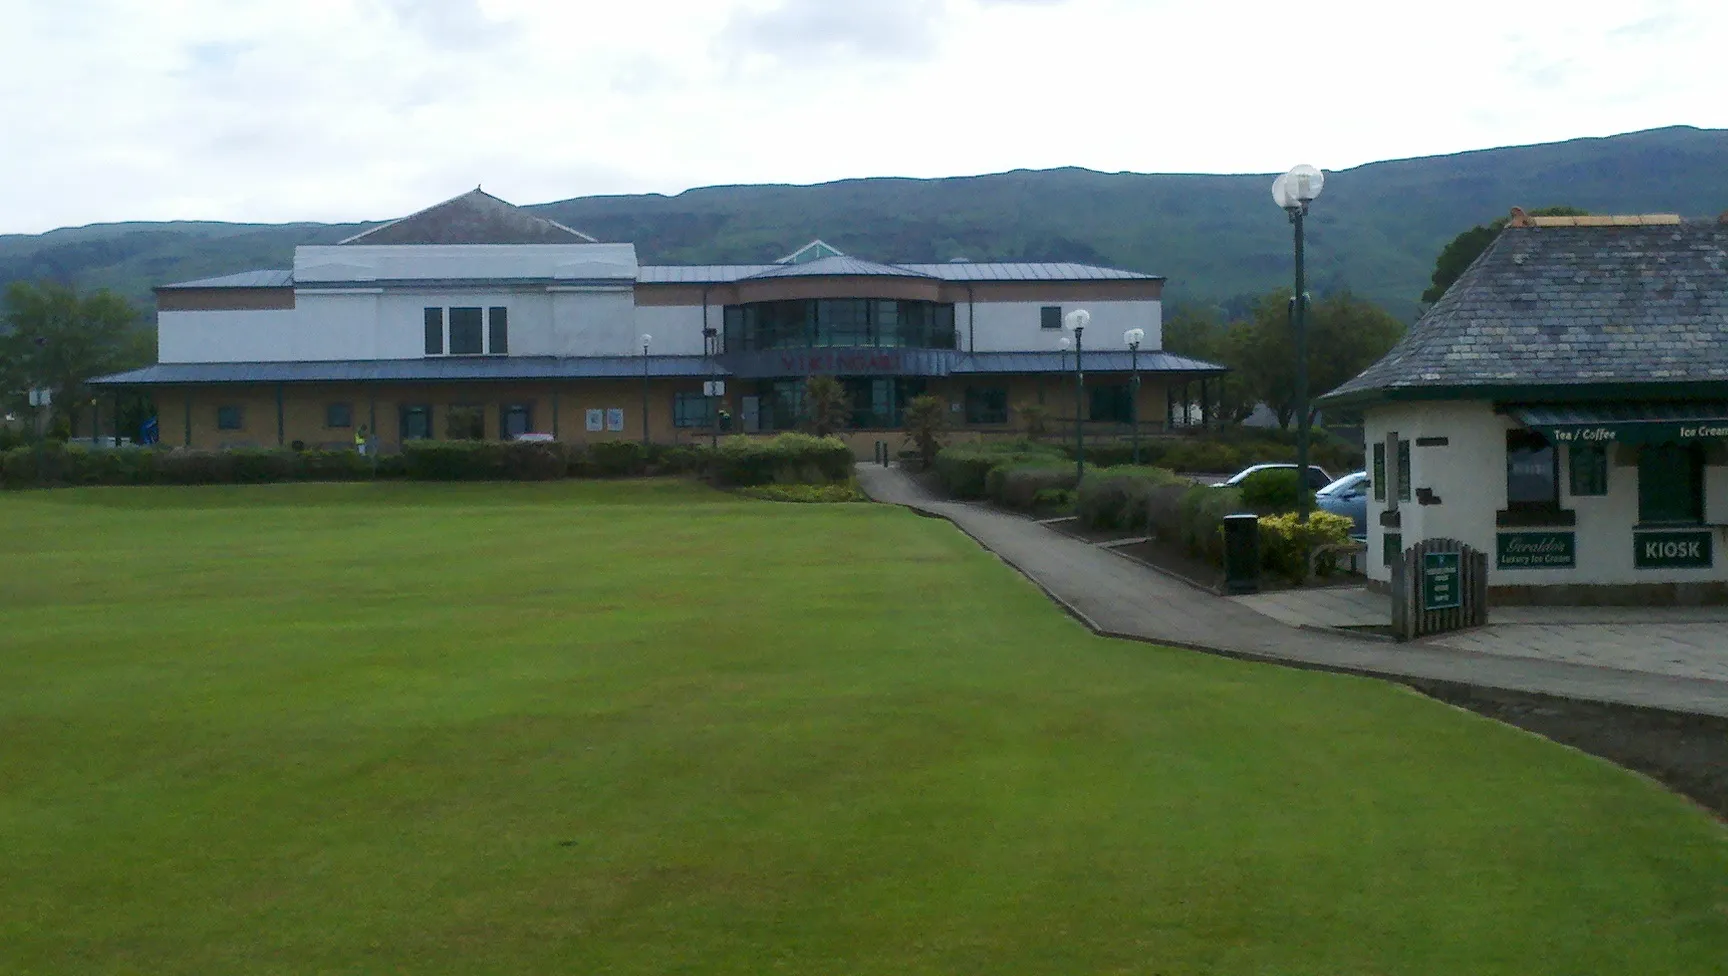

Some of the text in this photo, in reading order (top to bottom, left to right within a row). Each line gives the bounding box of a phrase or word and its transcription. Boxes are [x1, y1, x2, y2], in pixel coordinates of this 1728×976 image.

[1554, 430, 1572, 440] Tea
[1582, 428, 1616, 441] Coffee
[1680, 427, 1695, 437] Ice
[1645, 541, 1701, 559] KIOSK
[1531, 554, 1544, 563] Ice
[1545, 553, 1571, 563] Cream
